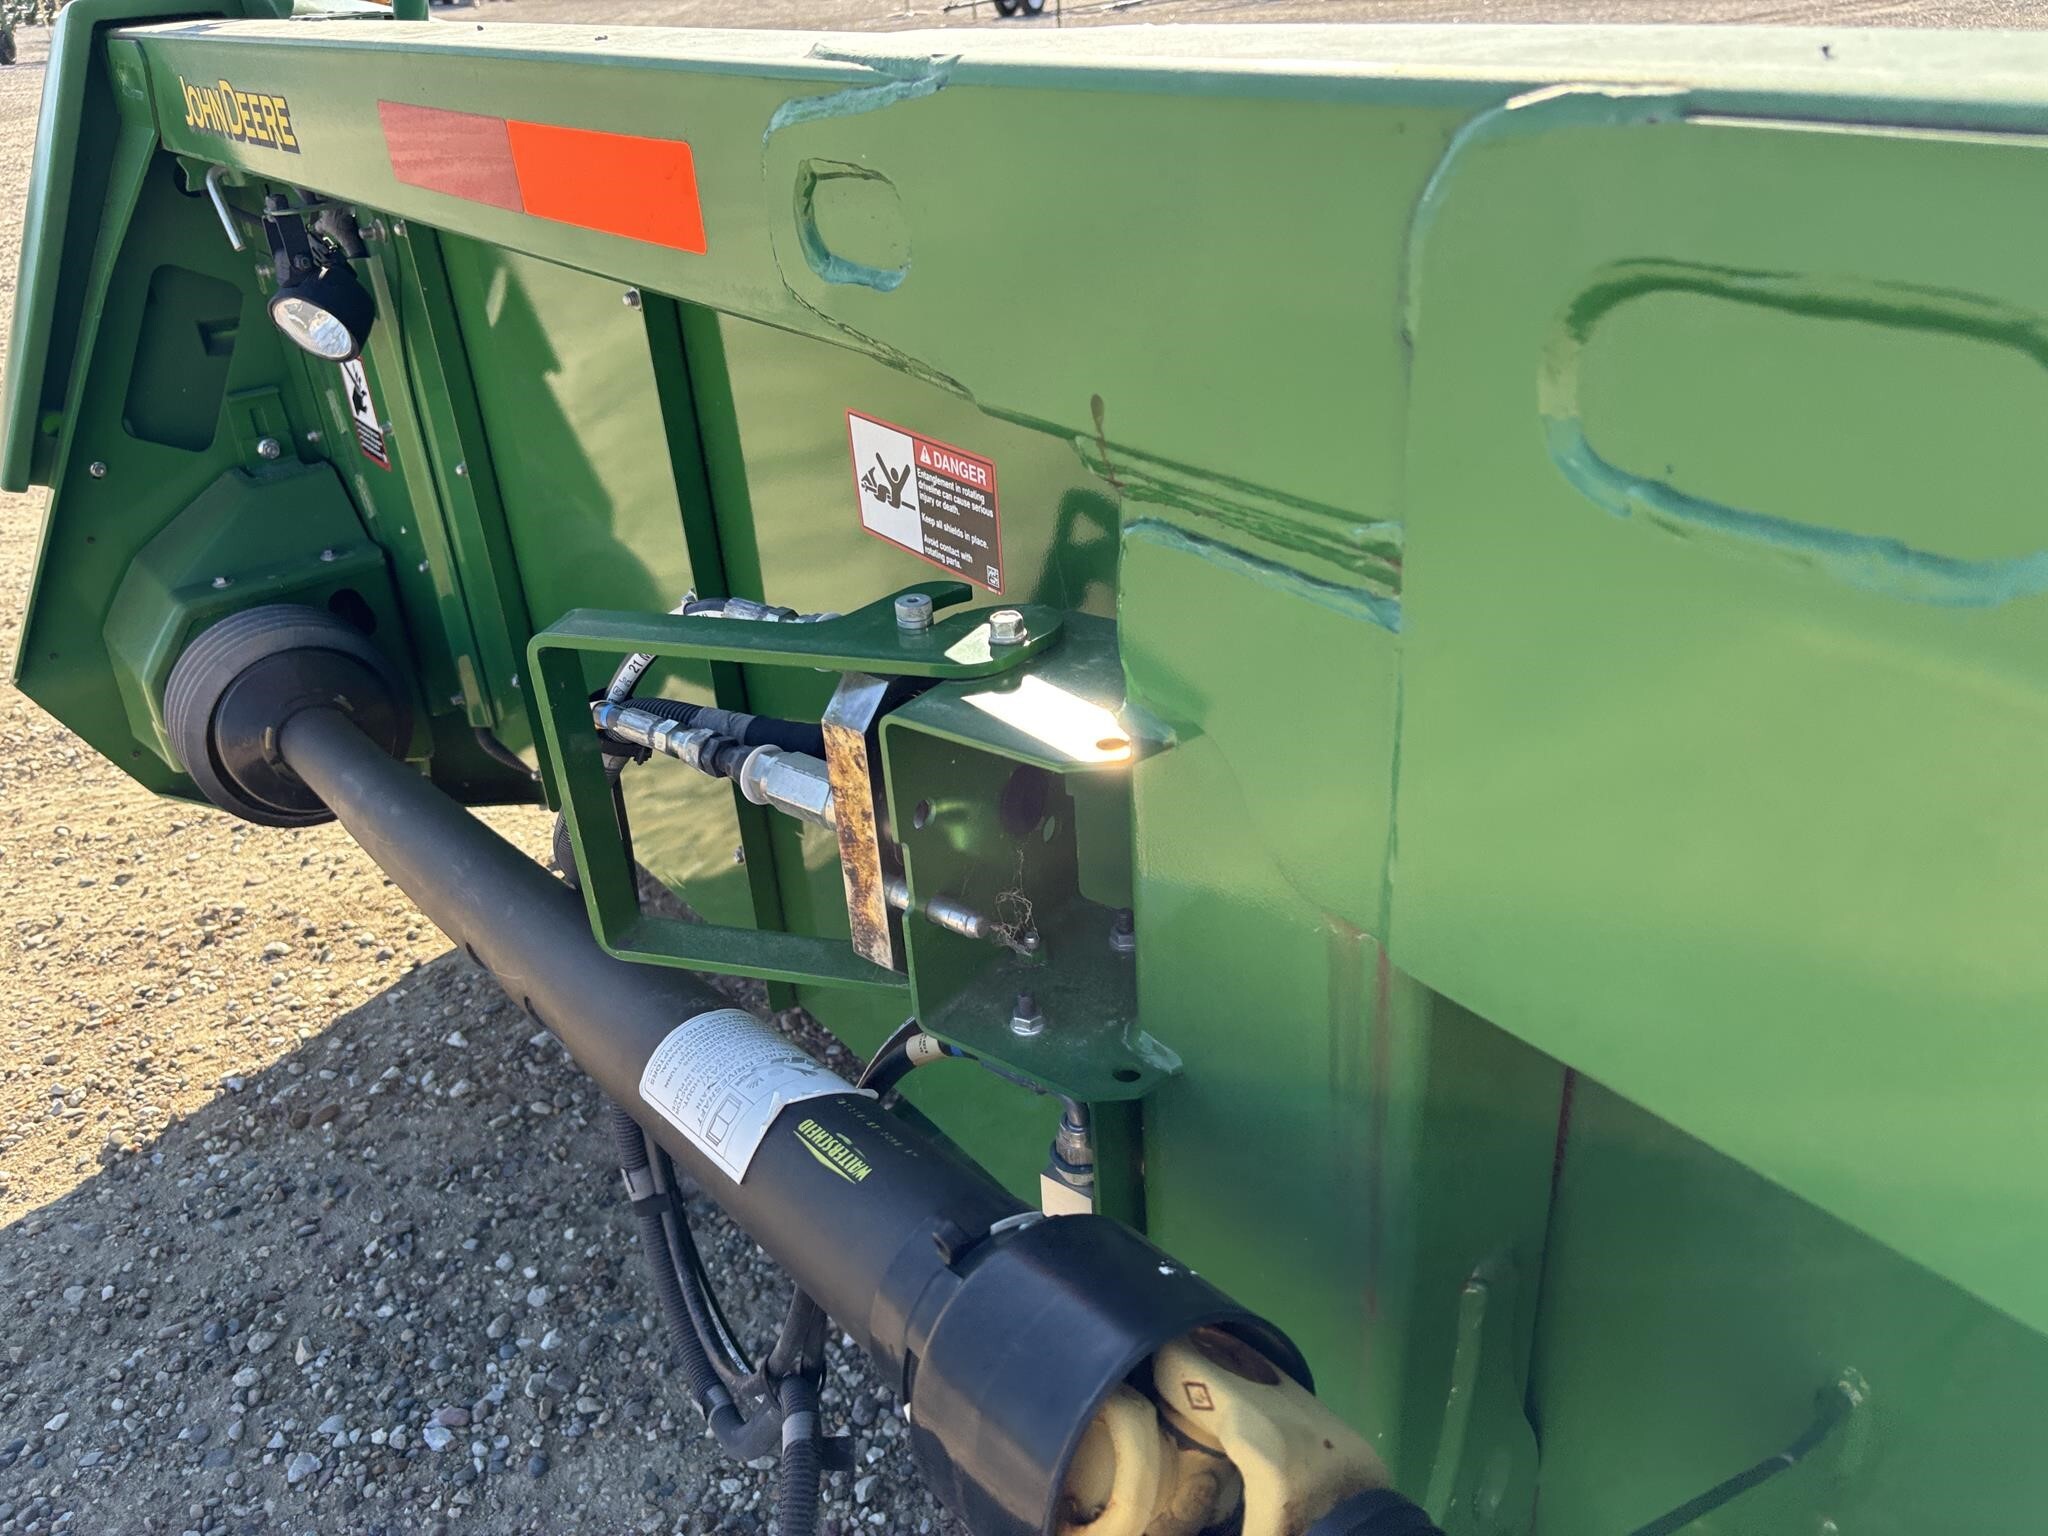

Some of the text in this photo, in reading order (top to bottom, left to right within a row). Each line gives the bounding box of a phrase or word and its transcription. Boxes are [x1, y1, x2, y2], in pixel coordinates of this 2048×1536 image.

[180, 74, 300, 153] JOHN DEERE
[917, 468, 985, 506] Entanglement in rotating
[933, 451, 987, 486] DANGER
[918, 480, 994, 518] driveline can cause serious
[919, 490, 960, 516] injury or death.
[921, 512, 935, 528] Keep
[943, 523, 964, 538] shields
[964, 530, 971, 541] in
[971, 535, 989, 550] place.
[924, 533, 973, 563] Avoid contact with
[924, 546, 962, 569] rotating parts.
[798, 1119, 872, 1182] WALTERSCHEID
